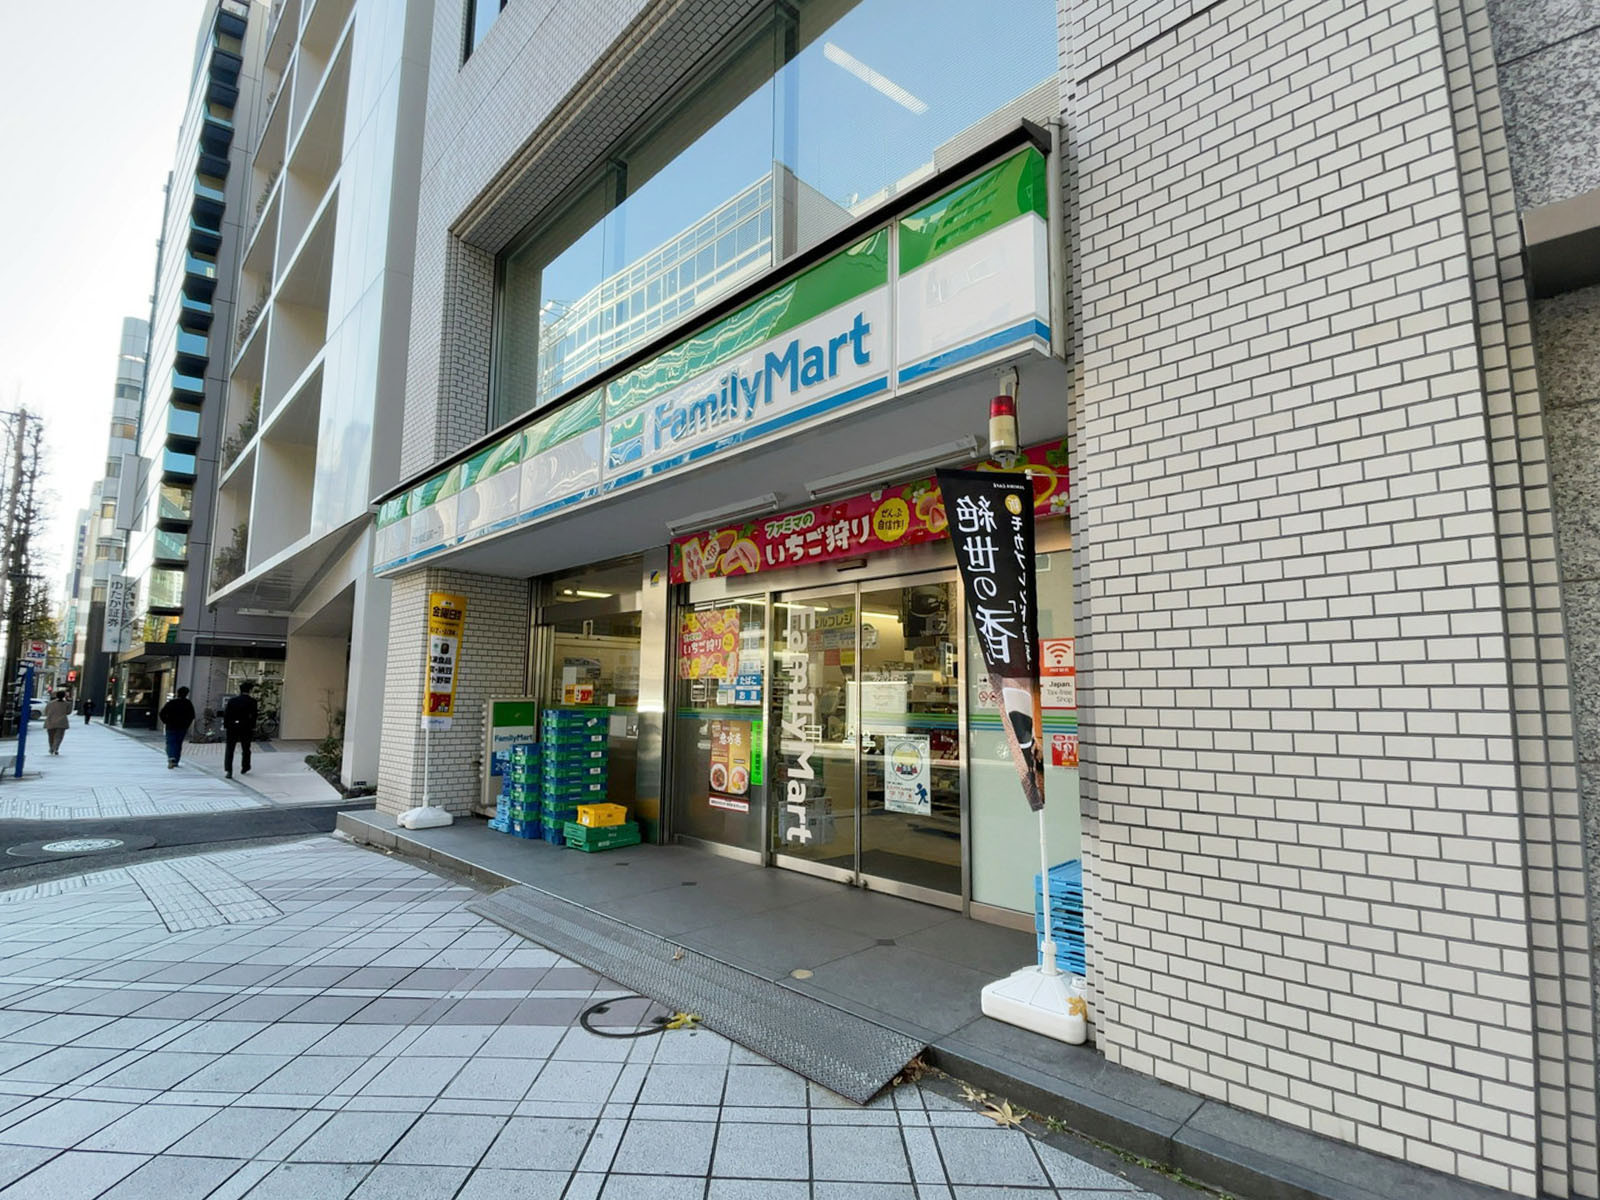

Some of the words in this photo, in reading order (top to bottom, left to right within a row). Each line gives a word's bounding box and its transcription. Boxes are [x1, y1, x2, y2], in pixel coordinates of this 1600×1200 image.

[653, 310, 872, 449] FamilyMart
[765, 511, 815, 538] ファミマの
[881, 507, 903, 518] ぜんぶ
[766, 515, 870, 565] いちご狩り
[107, 581, 123, 627] ゆたか証券
[740, 675, 757, 685] たばこ
[1056, 695, 1073, 704] Shop
[494, 734, 534, 744] FamilyMart
[782, 607, 816, 845] FamilyMart
